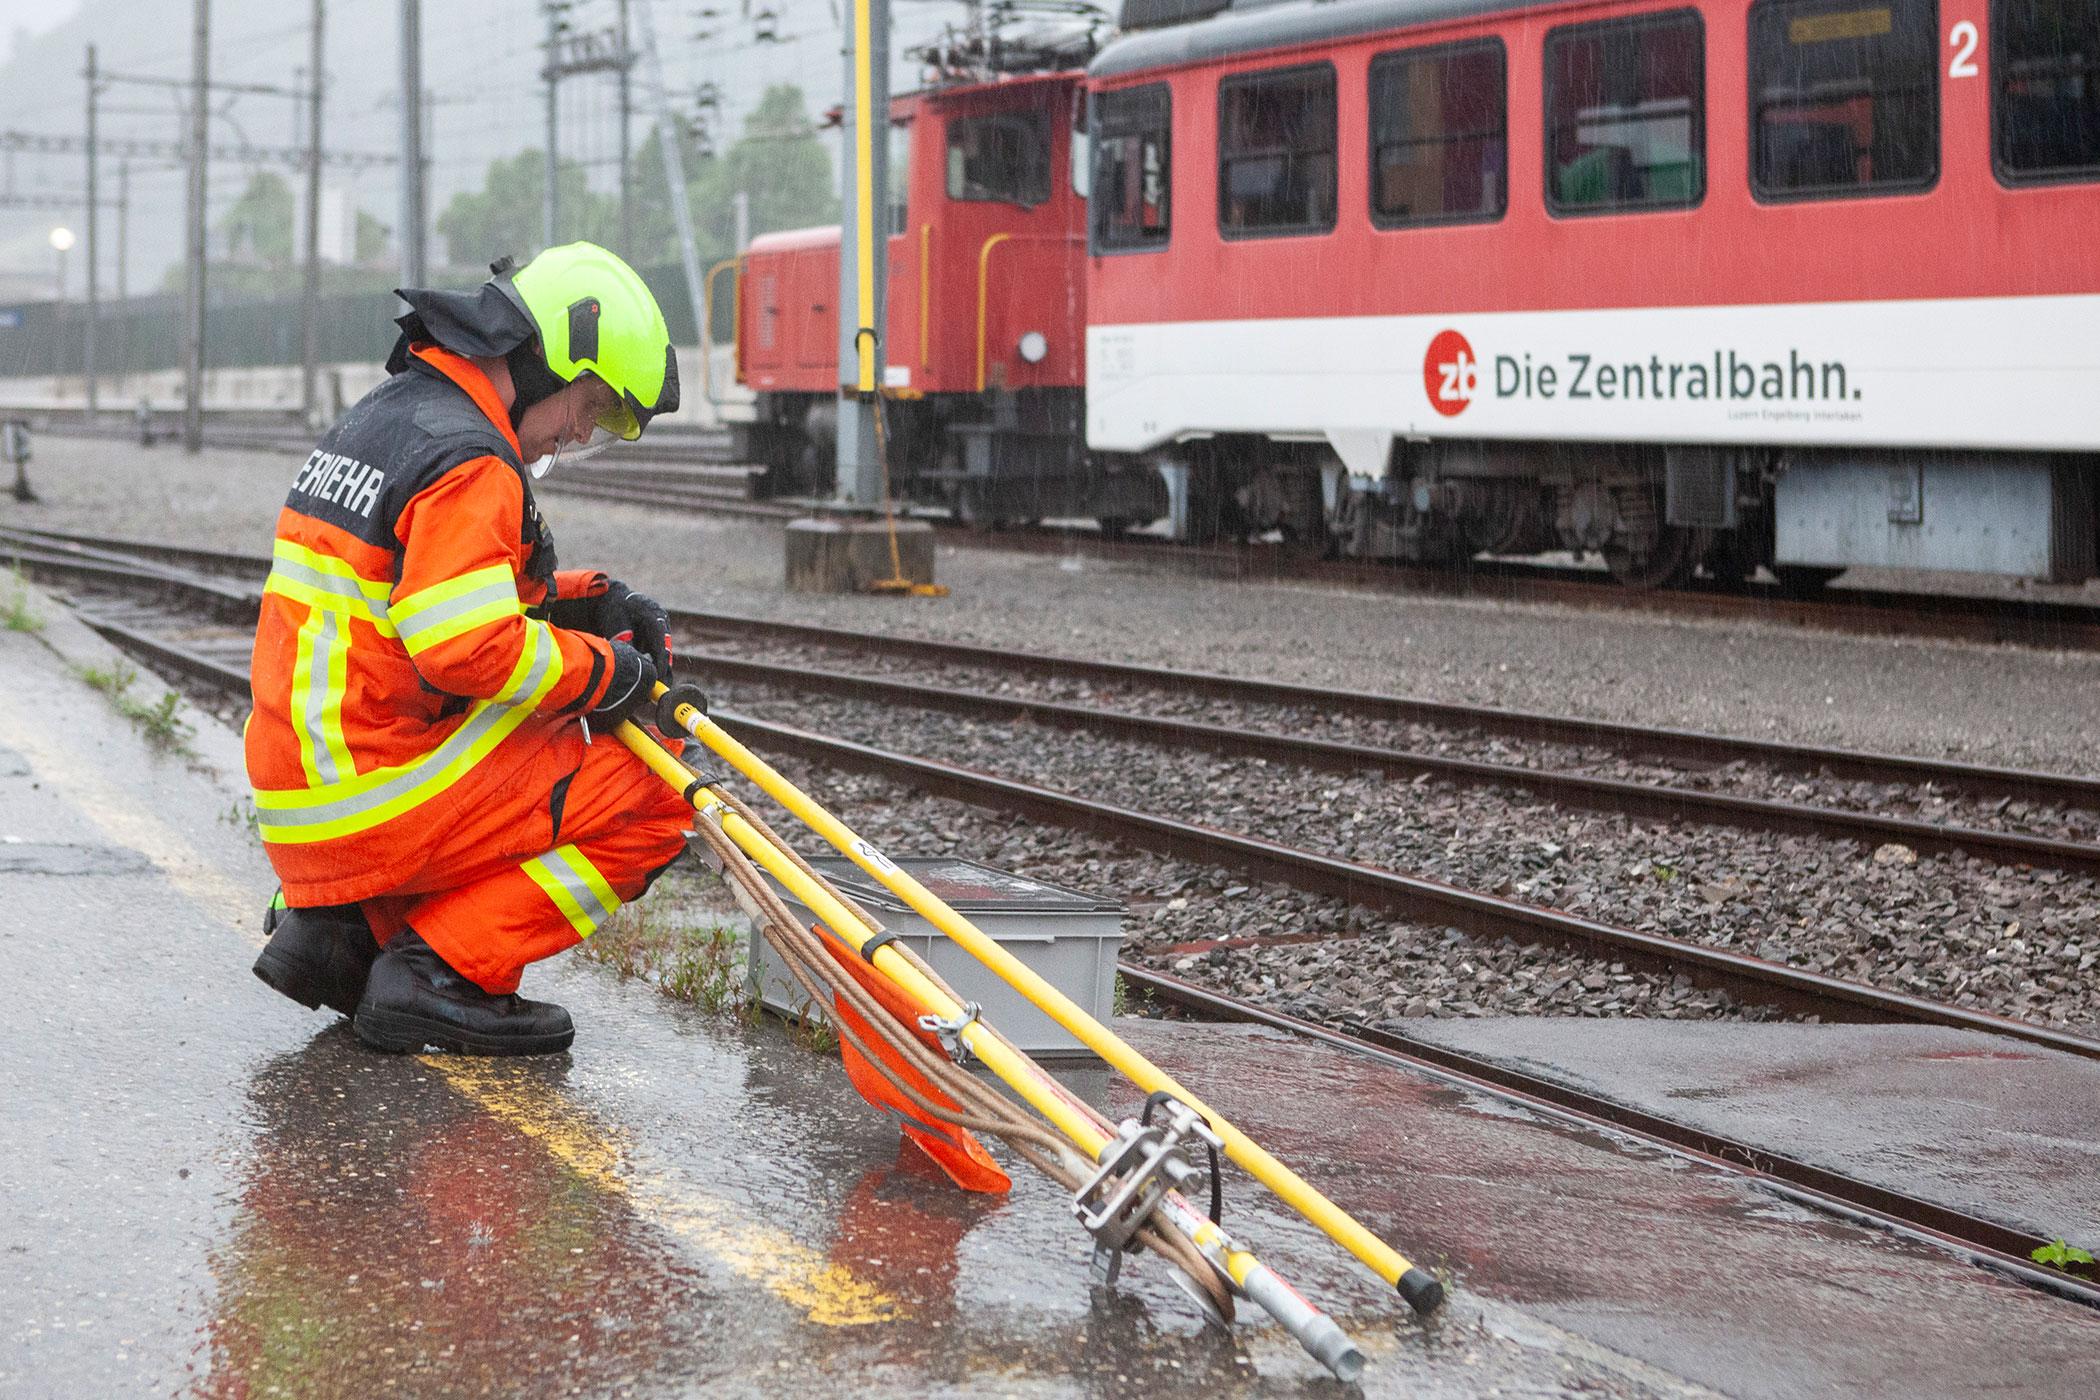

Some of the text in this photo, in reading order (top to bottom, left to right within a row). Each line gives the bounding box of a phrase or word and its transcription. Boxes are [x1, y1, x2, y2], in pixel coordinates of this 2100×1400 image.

[1949, 20, 1978, 78] 2
[1438, 350, 1478, 401] zb
[1495, 349, 1862, 400] Die Zentralbahn.
